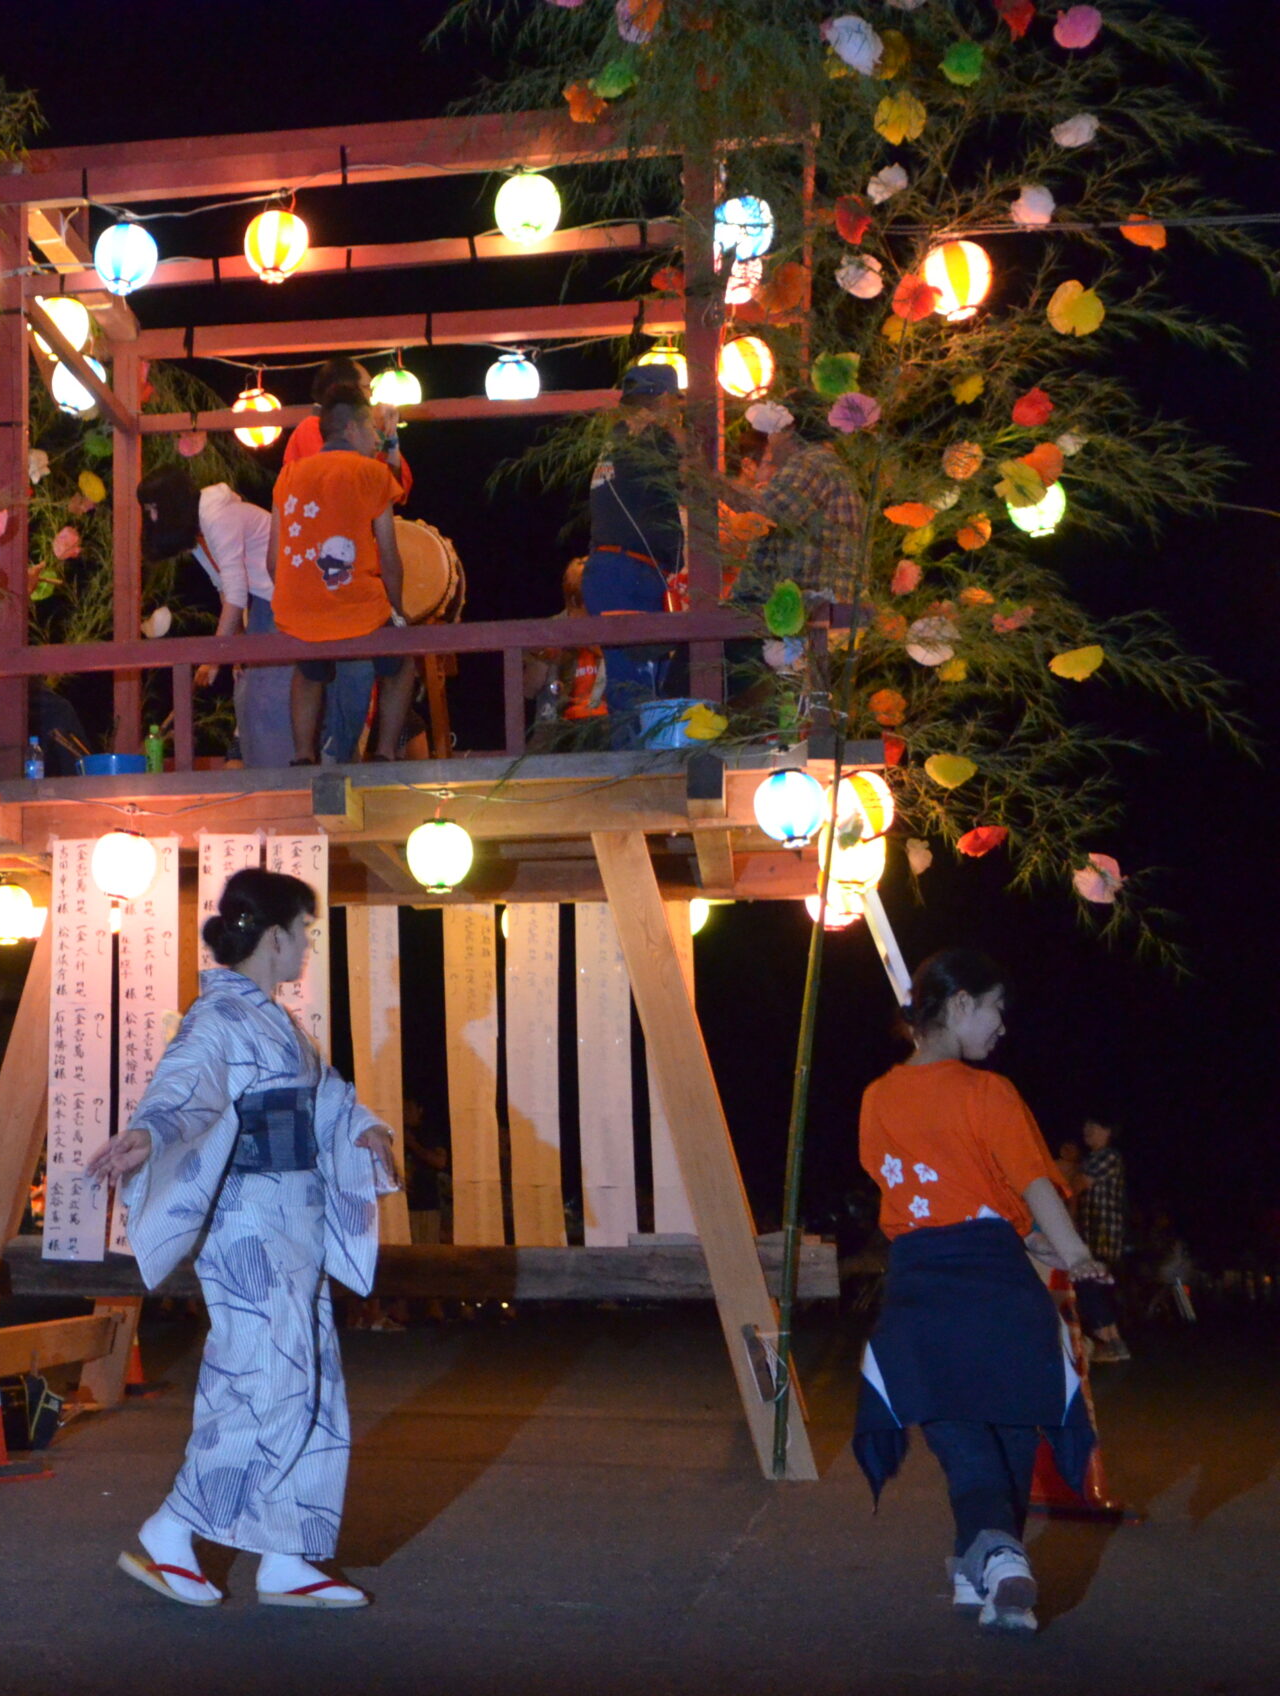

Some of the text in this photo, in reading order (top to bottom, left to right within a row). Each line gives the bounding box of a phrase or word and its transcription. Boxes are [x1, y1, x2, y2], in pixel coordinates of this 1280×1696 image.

[311, 844, 322, 870] のし
[311, 929, 321, 954] のし
[94, 1012, 105, 1039] のし
[311, 1013, 321, 1039] のし
[93, 1097, 104, 1124] のし
[91, 1184, 102, 1210] のし
